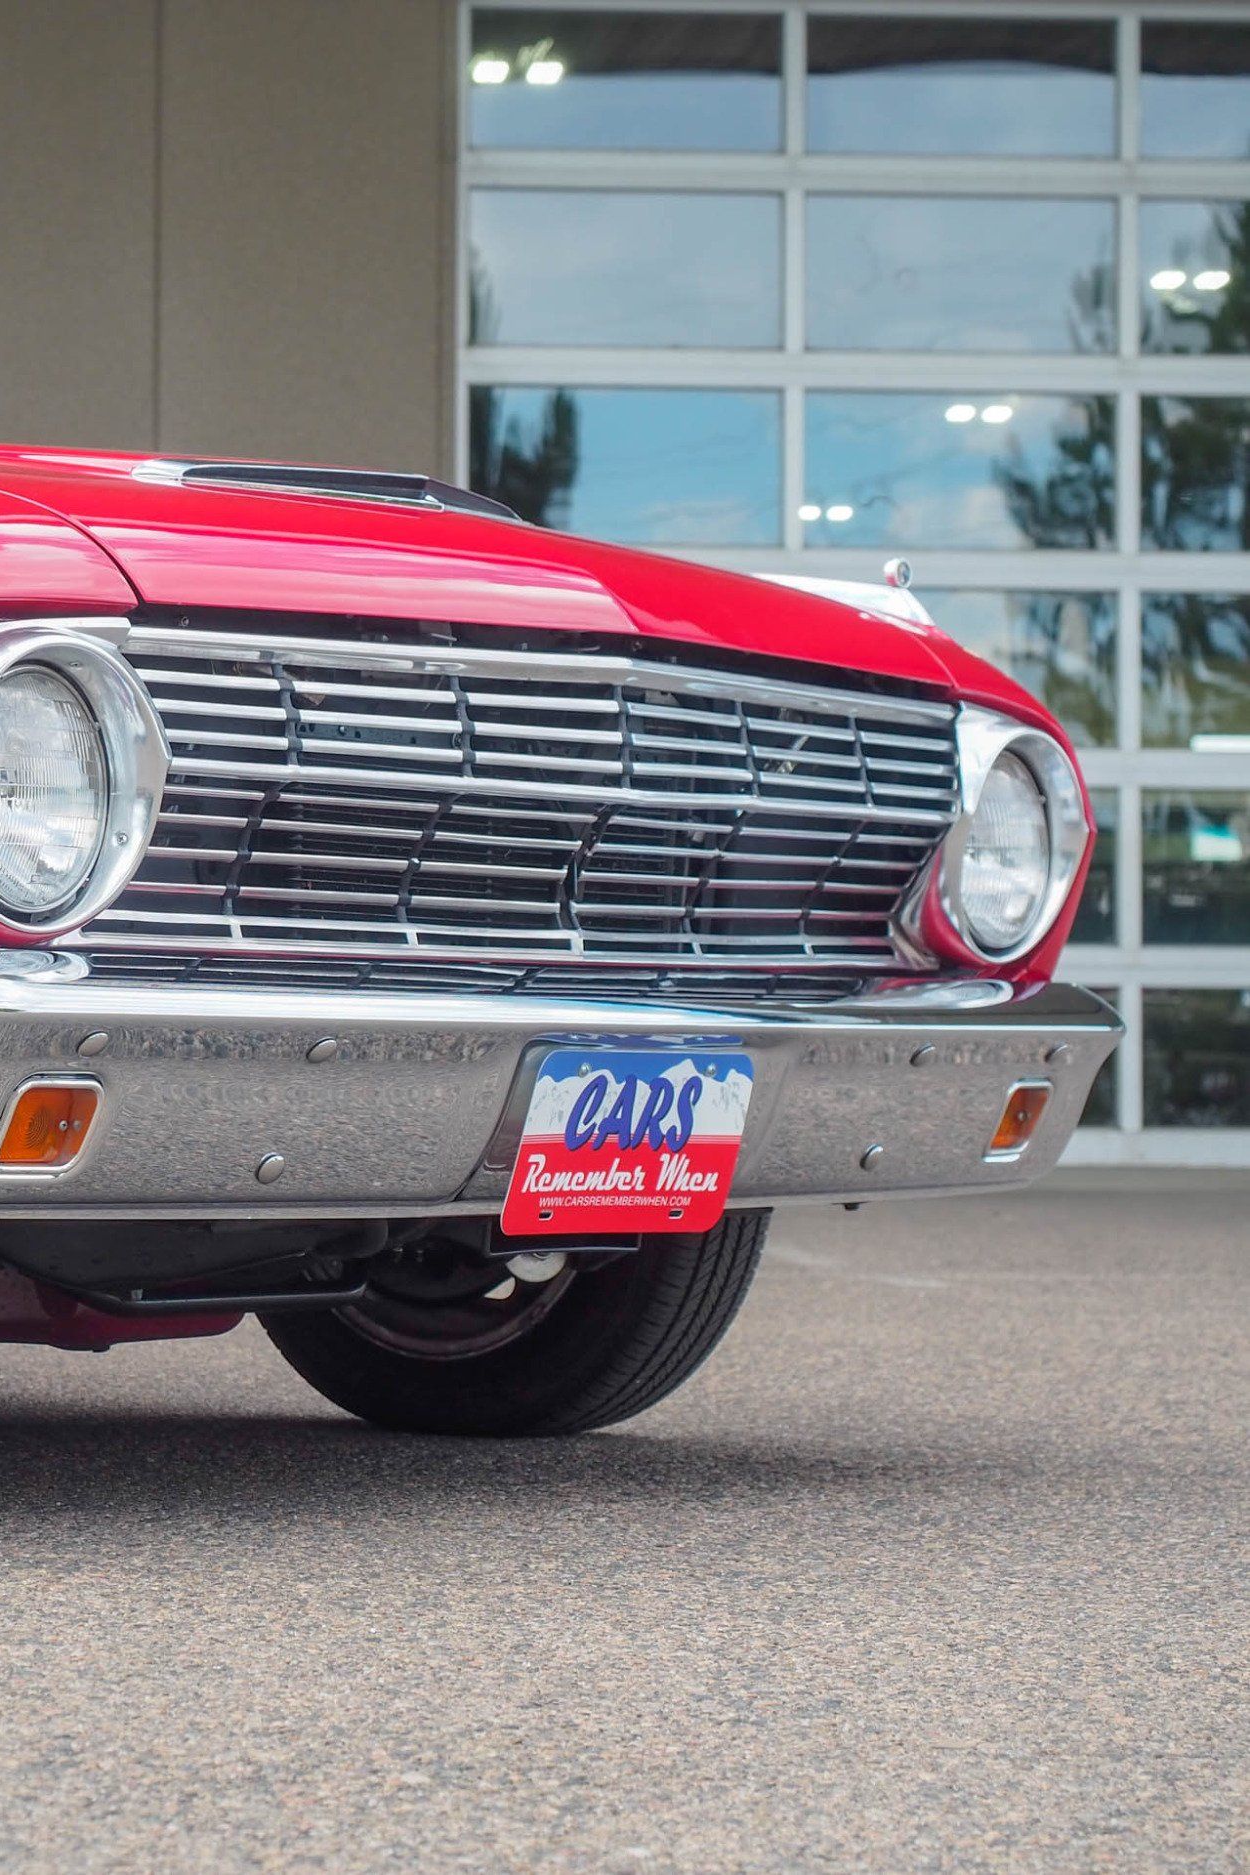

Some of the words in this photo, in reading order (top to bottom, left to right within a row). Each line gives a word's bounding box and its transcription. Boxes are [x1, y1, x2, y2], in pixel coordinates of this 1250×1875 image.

[563, 1074, 703, 1153] CARS
[521, 1153, 646, 1194] Remember
[655, 1153, 720, 1193] When
[539, 1195, 692, 1208] WWW.CARSREMEMBERWHEN.COM
